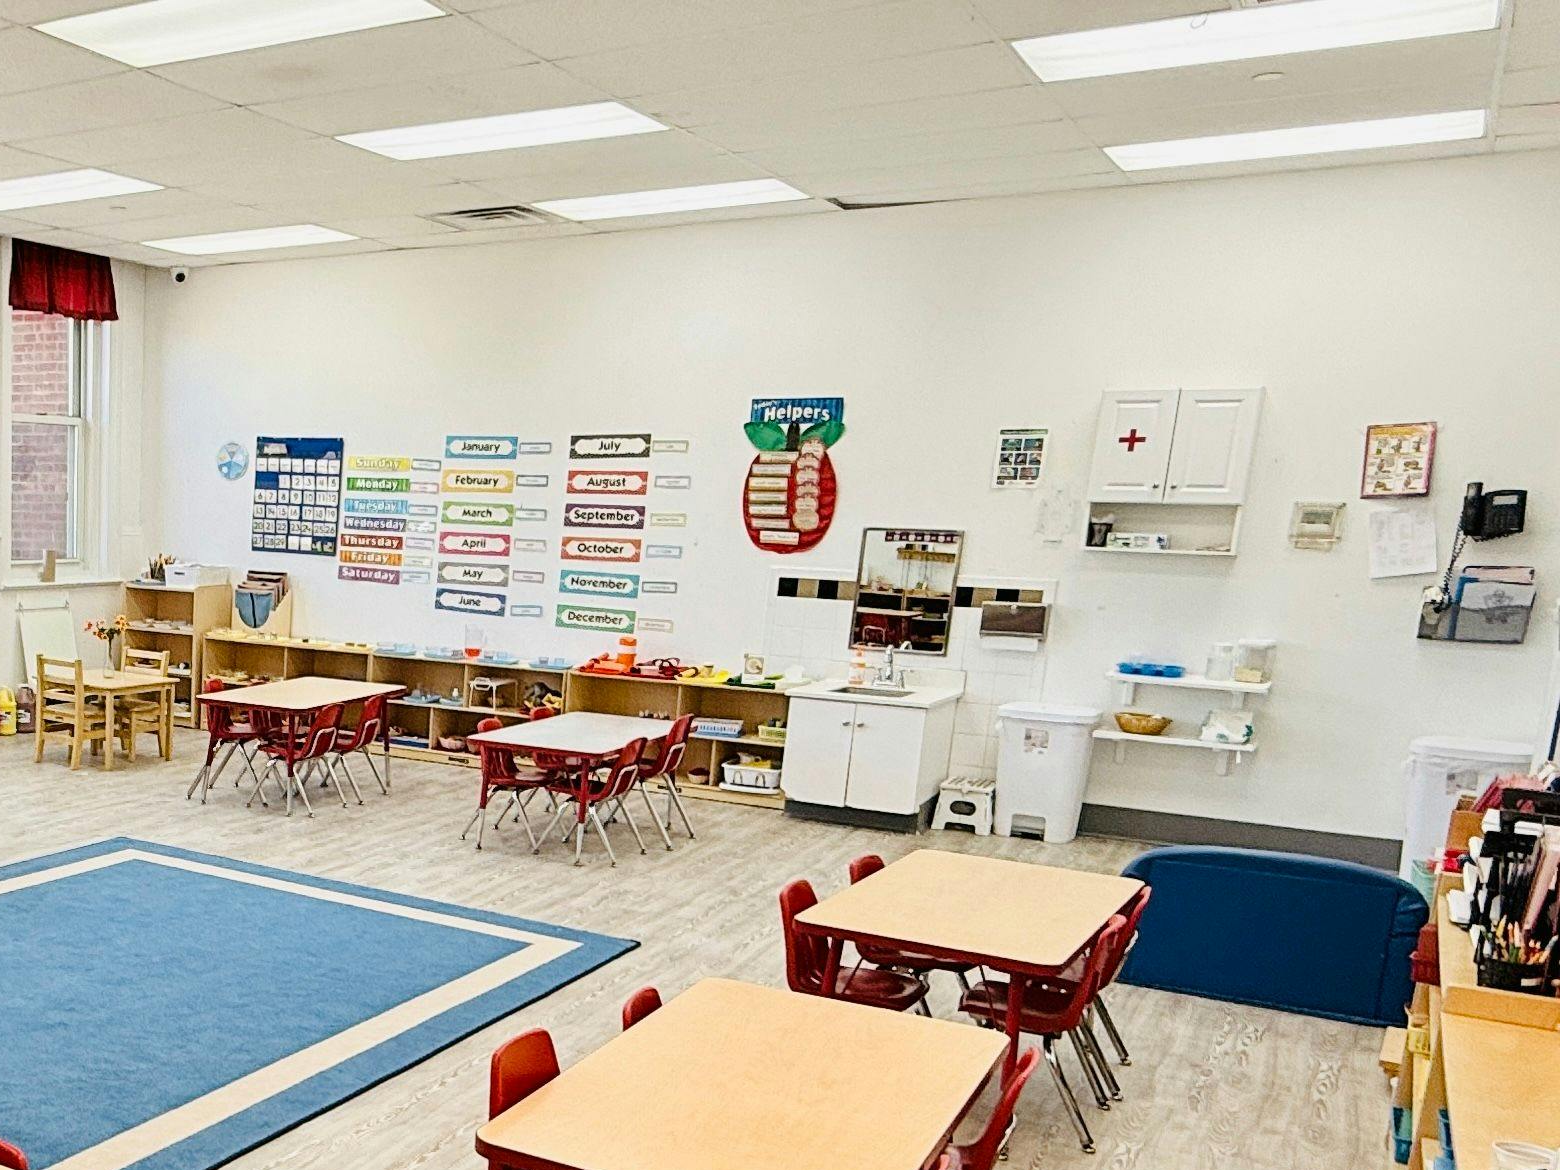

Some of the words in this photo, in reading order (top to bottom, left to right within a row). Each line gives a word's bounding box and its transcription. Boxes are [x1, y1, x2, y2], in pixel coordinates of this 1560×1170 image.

[764, 404, 830, 422] Helpers
[462, 442, 500, 452] January
[598, 441, 620, 452] July
[356, 459, 399, 469] Sunday
[356, 480, 398, 490] Monday
[456, 476, 499, 486] February
[587, 478, 626, 488] August
[353, 501, 397, 512] Tuesday
[462, 509, 492, 517] March
[574, 510, 635, 521] September
[346, 517, 404, 530] Wednesday
[343, 536, 399, 546] Thursday
[462, 539, 486, 548] April
[578, 543, 624, 554] October
[352, 553, 389, 563] Friday
[342, 569, 395, 581] Saturday
[462, 569, 483, 579] May
[571, 576, 627, 590] November
[458, 596, 481, 606] June
[568, 611, 623, 625] December
